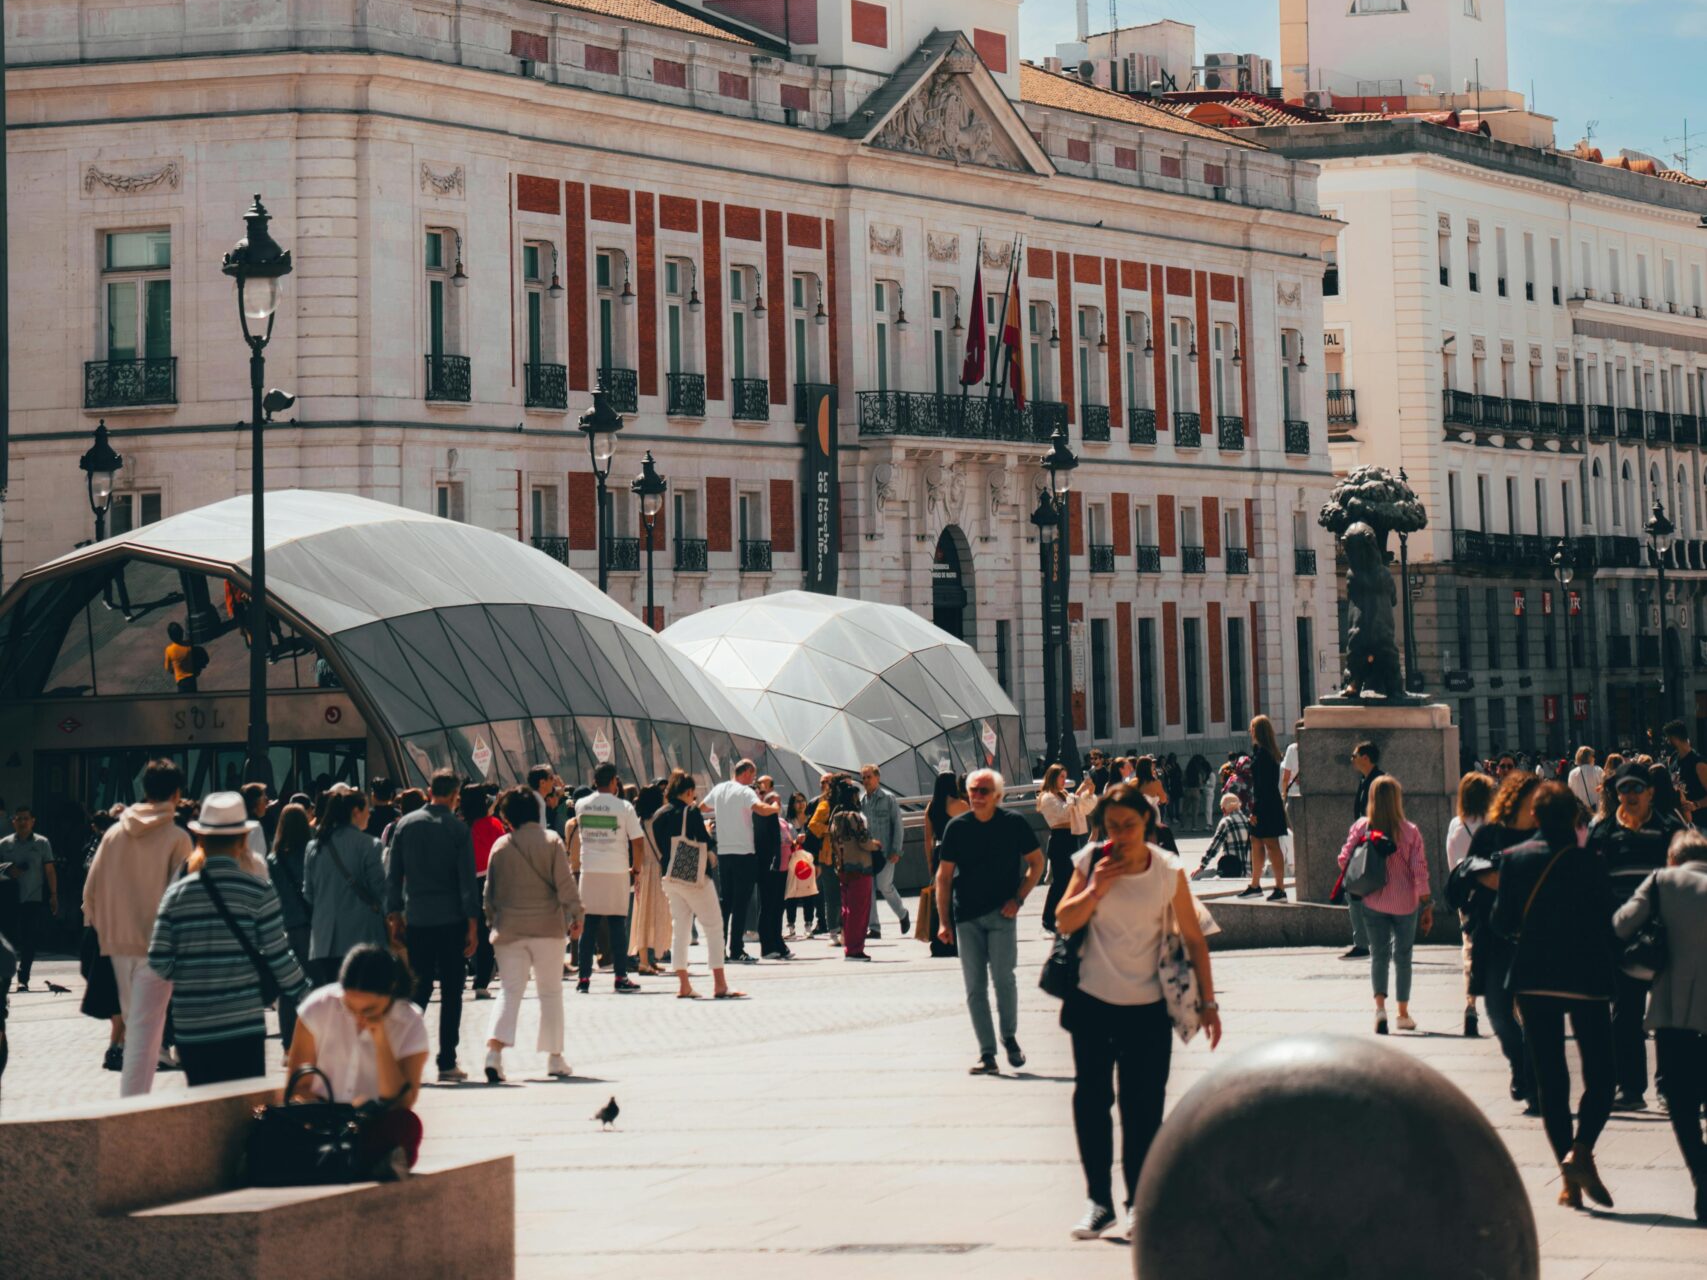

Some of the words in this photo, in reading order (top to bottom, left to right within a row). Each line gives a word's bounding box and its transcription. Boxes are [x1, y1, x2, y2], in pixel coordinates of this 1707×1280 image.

[817, 471, 824, 493] de
[823, 471, 829, 493] La
[174, 708, 225, 730] SOL
